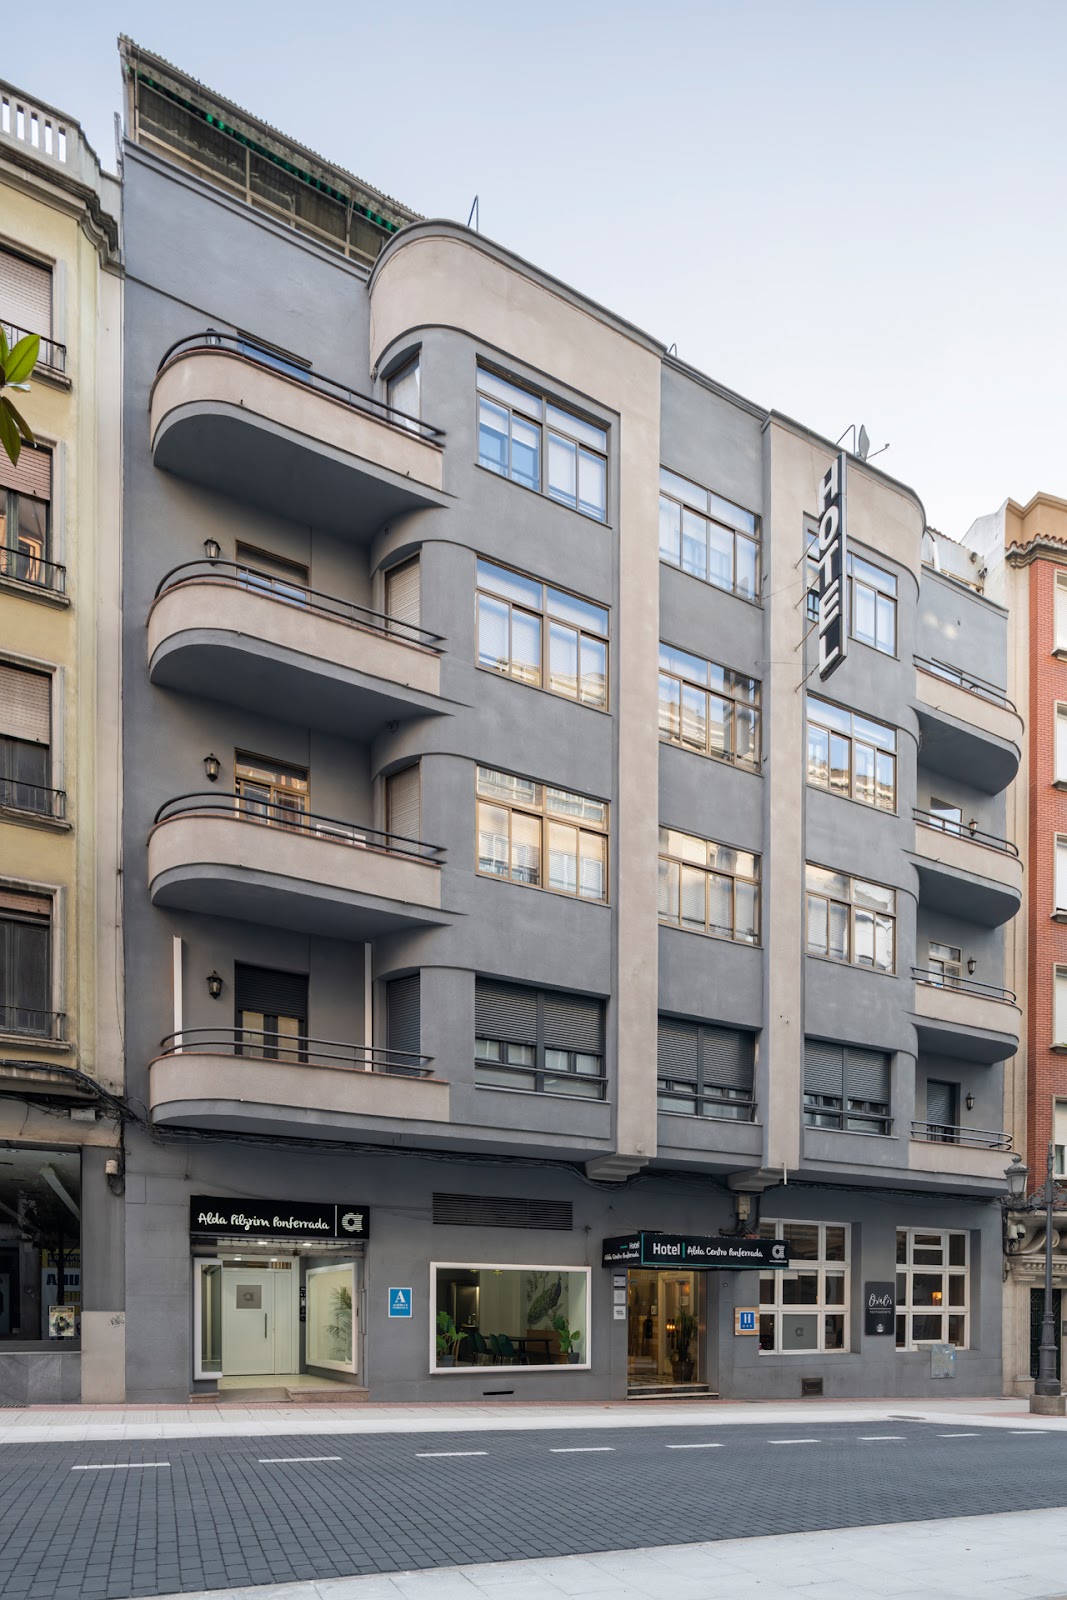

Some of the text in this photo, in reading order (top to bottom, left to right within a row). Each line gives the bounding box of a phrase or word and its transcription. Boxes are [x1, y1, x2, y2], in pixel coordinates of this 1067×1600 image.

[819, 458, 840, 672] HOTEL
[198, 1212, 330, 1231] Alda Pilgrim Ponferrada
[653, 1242, 764, 1258] Hotel Alda Centro Ponferrada
[395, 1290, 406, 1303] A
[744, 1313, 751, 1323] H
